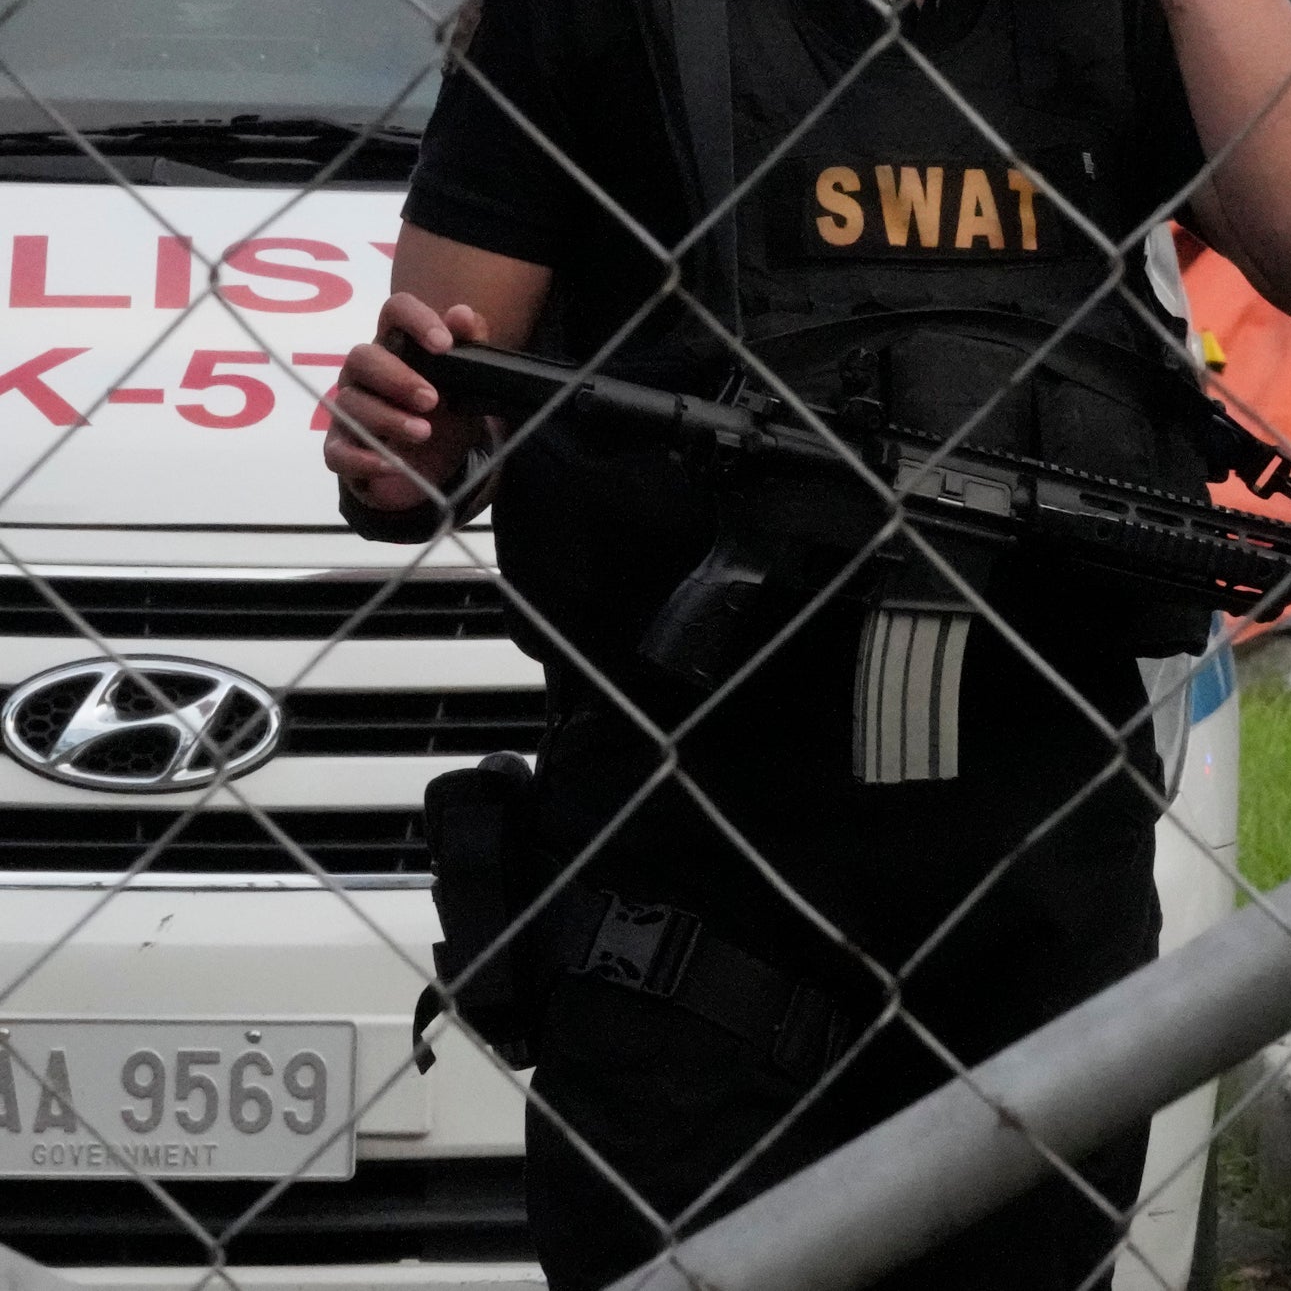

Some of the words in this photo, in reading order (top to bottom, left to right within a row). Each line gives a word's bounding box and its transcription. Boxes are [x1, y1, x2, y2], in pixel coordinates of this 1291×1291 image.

[815, 164, 1043, 251] SWAT
[9, 234, 396, 314] LIS
[120, 1049, 328, 1135] 9569
[31, 1142, 218, 1168] GOVERNMENT
